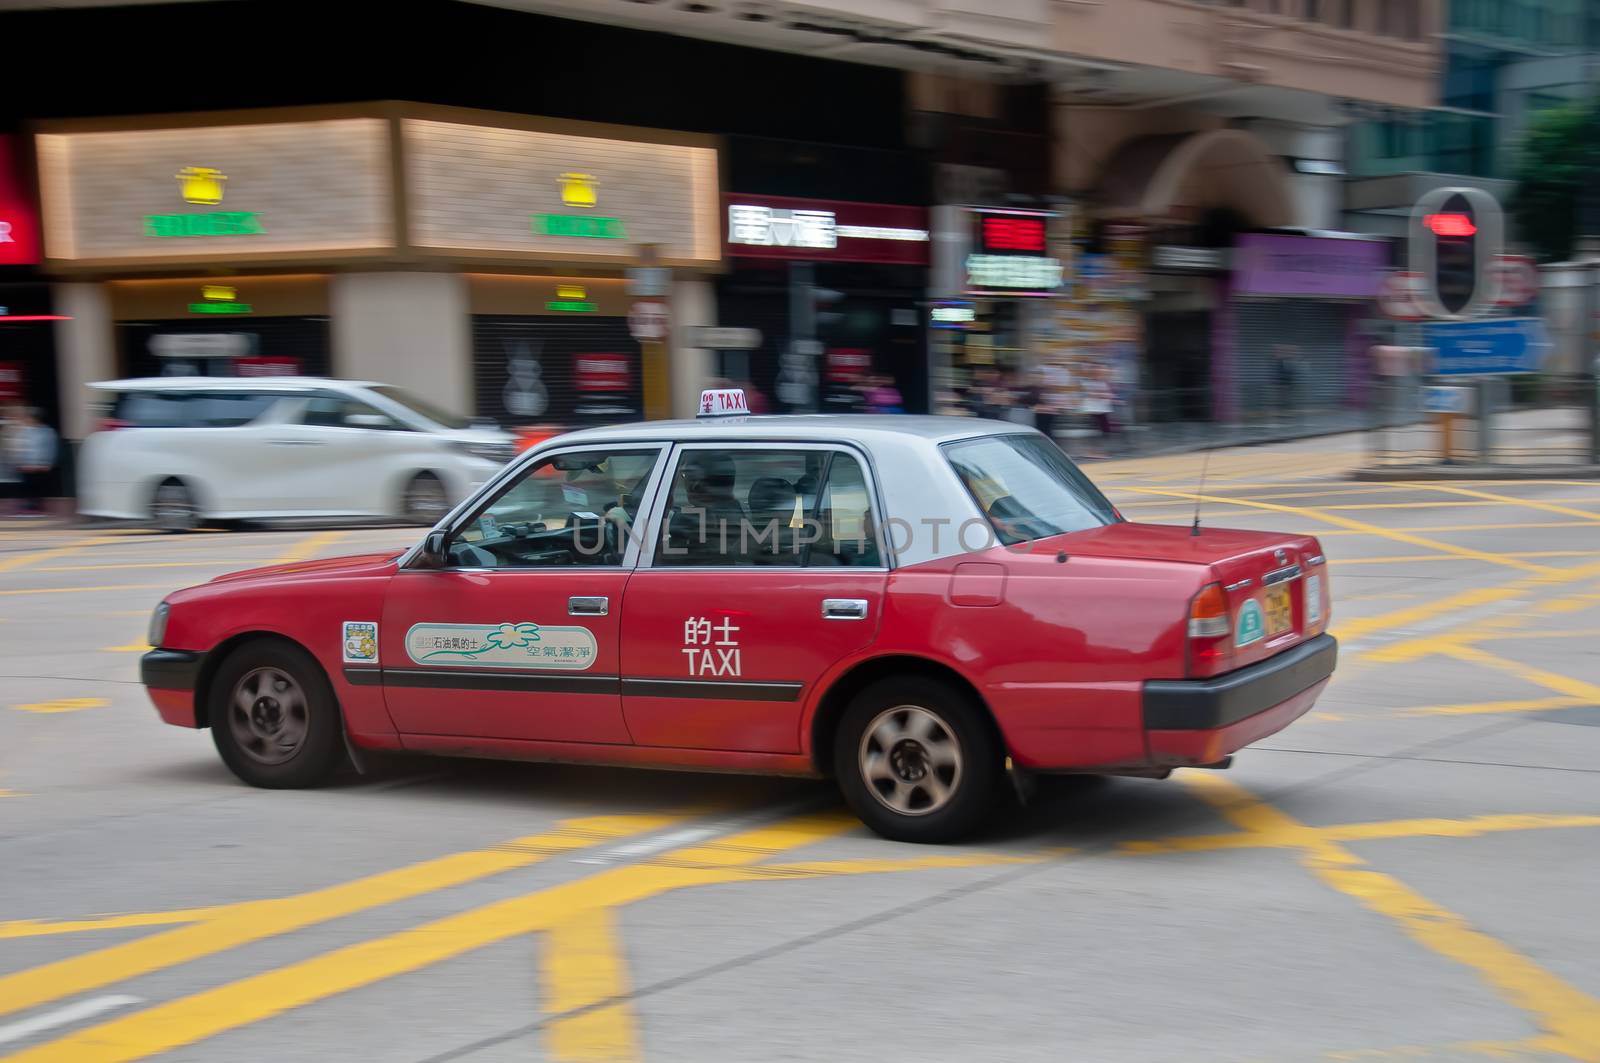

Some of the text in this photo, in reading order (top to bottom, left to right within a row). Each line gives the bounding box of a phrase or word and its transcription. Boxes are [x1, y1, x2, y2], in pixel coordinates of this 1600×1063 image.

[718, 393, 746, 409] TAXI
[684, 616, 740, 646] 的士
[527, 646, 591, 657] 空氣潔淨
[682, 648, 741, 676] TAXI
